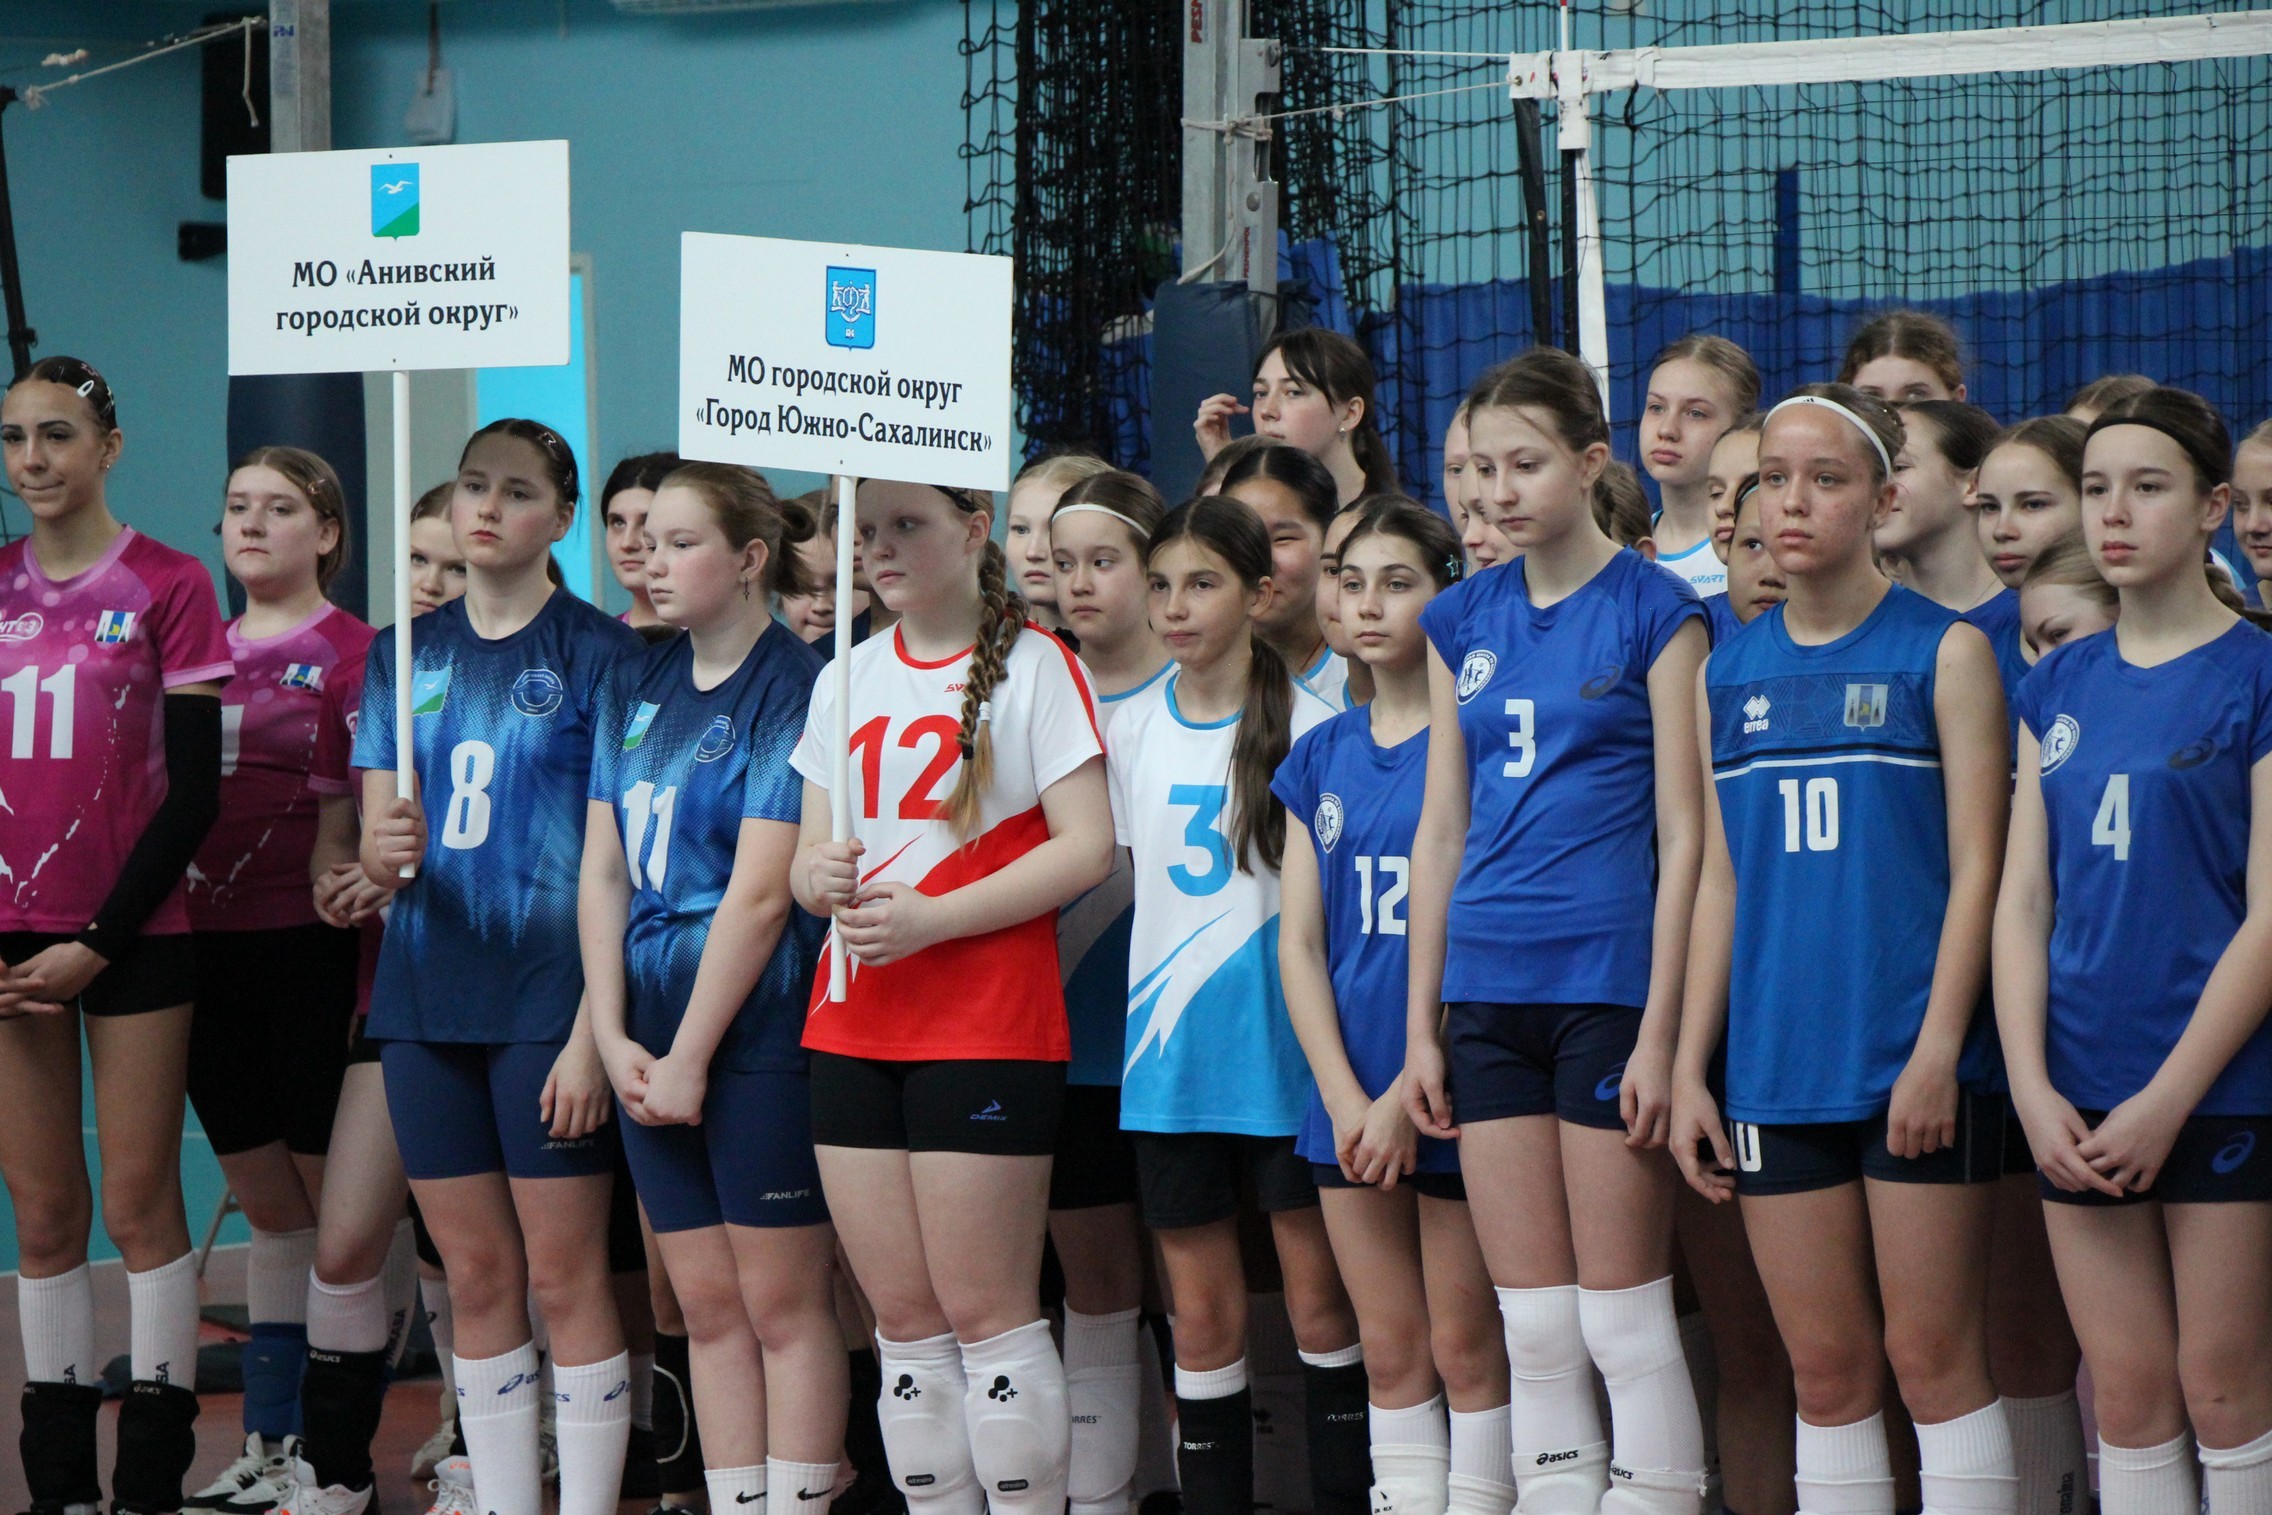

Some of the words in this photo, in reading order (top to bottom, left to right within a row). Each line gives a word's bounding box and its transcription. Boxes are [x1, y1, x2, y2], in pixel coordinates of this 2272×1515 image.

[292, 260, 337, 288] МО
[346, 255, 495, 285] «Анивский
[276, 301, 420, 336] городской
[428, 303, 518, 331] округ»
[727, 354, 765, 385] МО
[772, 366, 891, 397] городской
[897, 378, 963, 410] округ
[696, 397, 771, 435] «Город
[778, 405, 991, 452] Южно-Сахалинск»
[1, 664, 76, 760] 11
[1503, 699, 1536, 778] 3
[441, 740, 495, 850] 8
[848, 714, 963, 821] 12
[622, 780, 677, 894] 11
[1166, 784, 1234, 897] 3
[1778, 777, 1839, 853] 10
[2092, 774, 2132, 861] 4
[1355, 856, 1410, 935] 12
[764, 1189, 810, 1200] FANLIFE
[1548, 1450, 1579, 1463] asics
